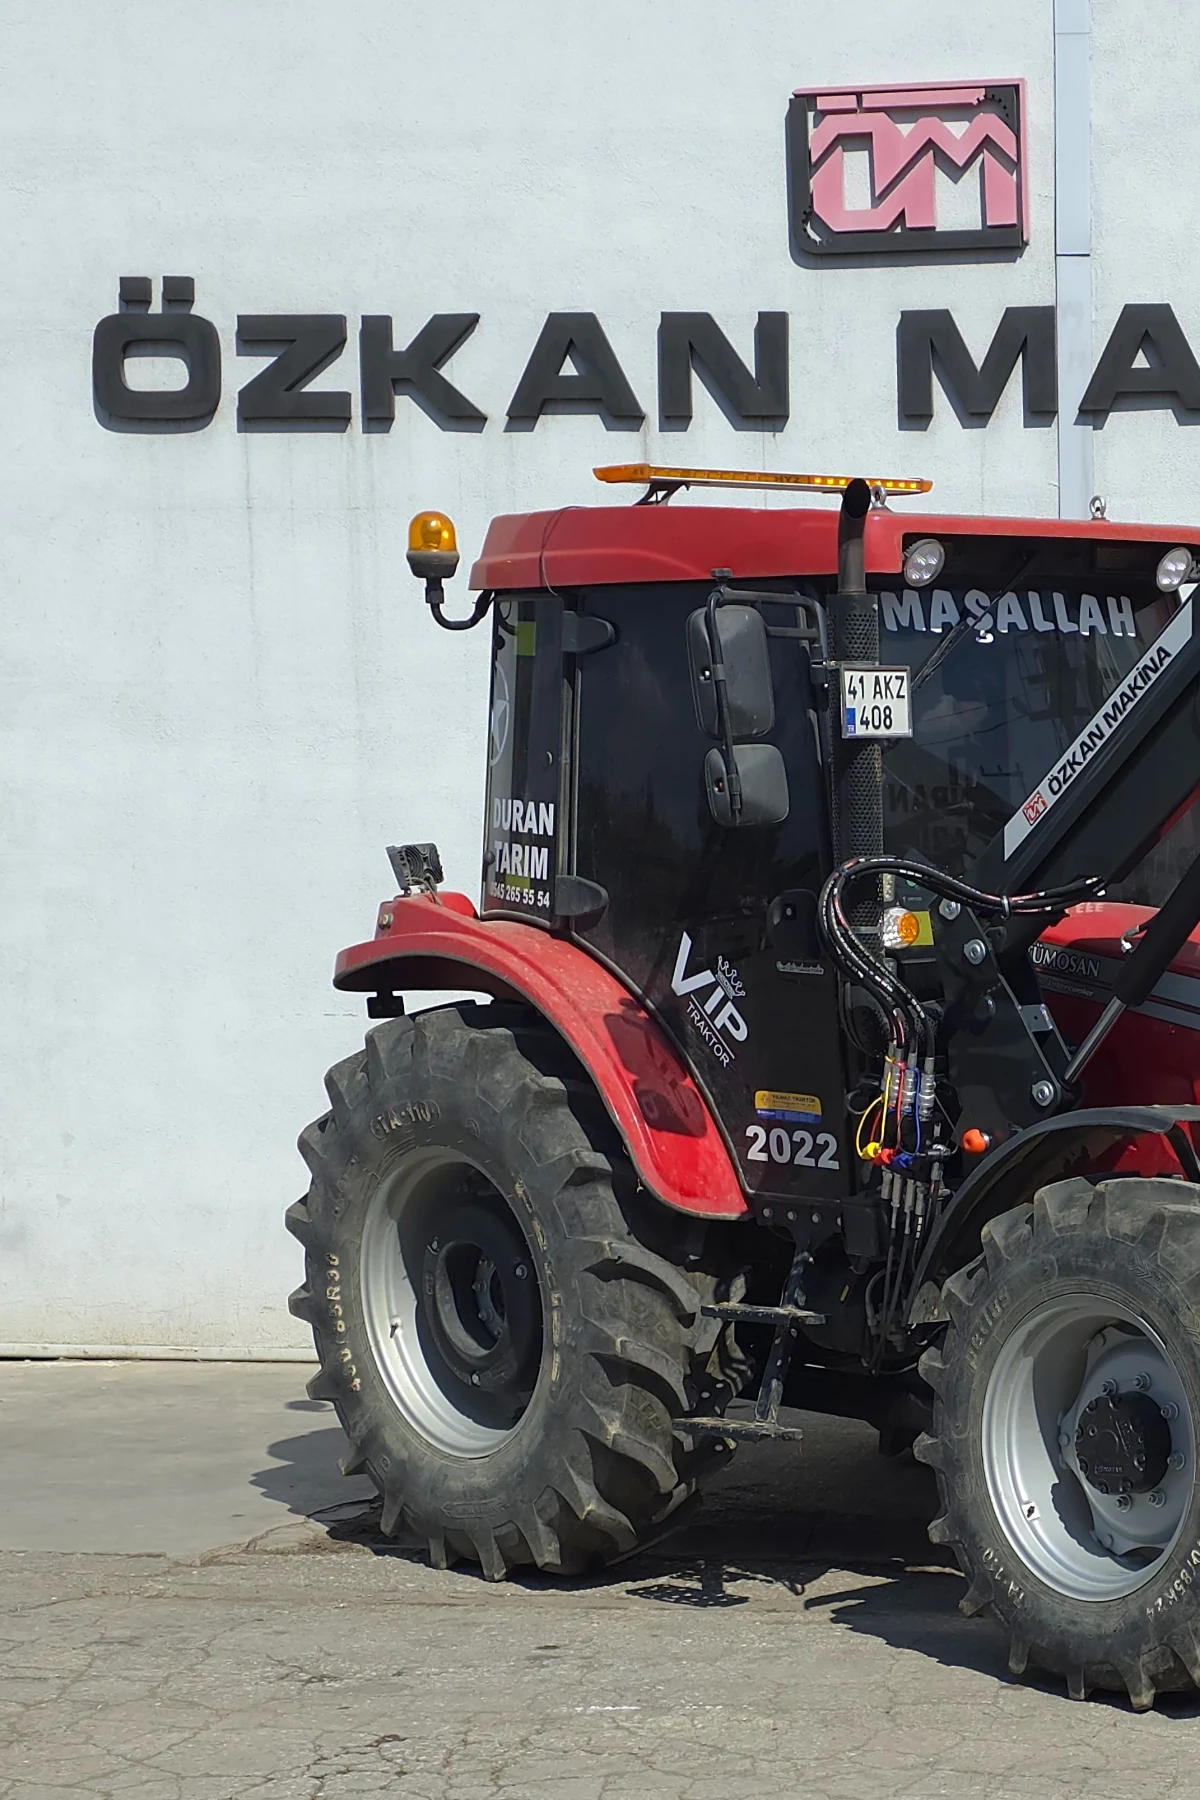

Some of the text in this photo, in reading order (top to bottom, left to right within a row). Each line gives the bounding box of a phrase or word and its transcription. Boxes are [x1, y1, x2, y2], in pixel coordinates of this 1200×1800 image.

[92, 276, 790, 424] ÖZKAN
[879, 588, 1137, 643] MAŞALLAH
[847, 674, 906, 700] 41 AKZ
[859, 704, 893, 730] 408
[1047, 723, 1106, 796] ÖZKAN
[1102, 645, 1173, 729] MAKİNA
[493, 797, 555, 837] DURAN
[494, 840, 549, 881] TARIM
[505, 884, 521, 903] 265
[522, 888, 535, 906] 55
[536, 891, 550, 908] 54
[671, 931, 748, 1042] VIP
[685, 1001, 731, 1068] TRAKTOR
[744, 1125, 840, 1170] 2022
